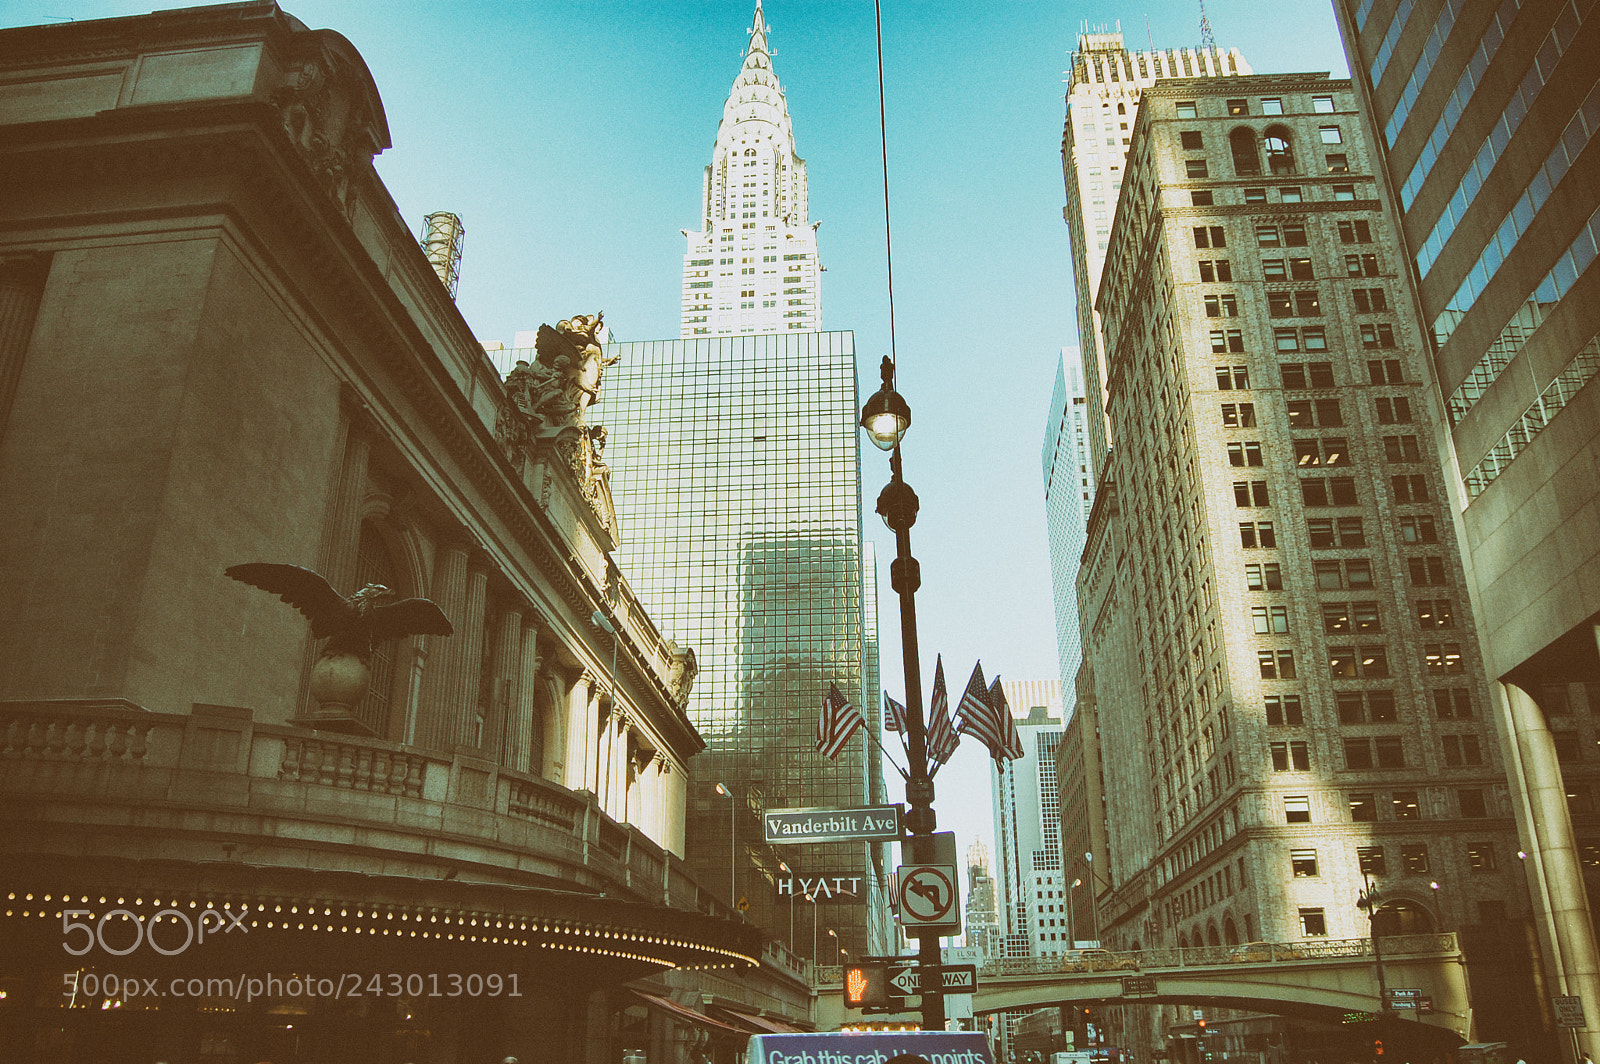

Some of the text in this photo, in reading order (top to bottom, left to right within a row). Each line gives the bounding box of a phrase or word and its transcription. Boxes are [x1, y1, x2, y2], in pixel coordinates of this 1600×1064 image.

[768, 815, 895, 835] Vanderbilt Ave
[778, 877, 861, 898] HYATT
[941, 973, 968, 985] WAY
[769, 1050, 816, 1064] Grab
[817, 1050, 852, 1064] this
